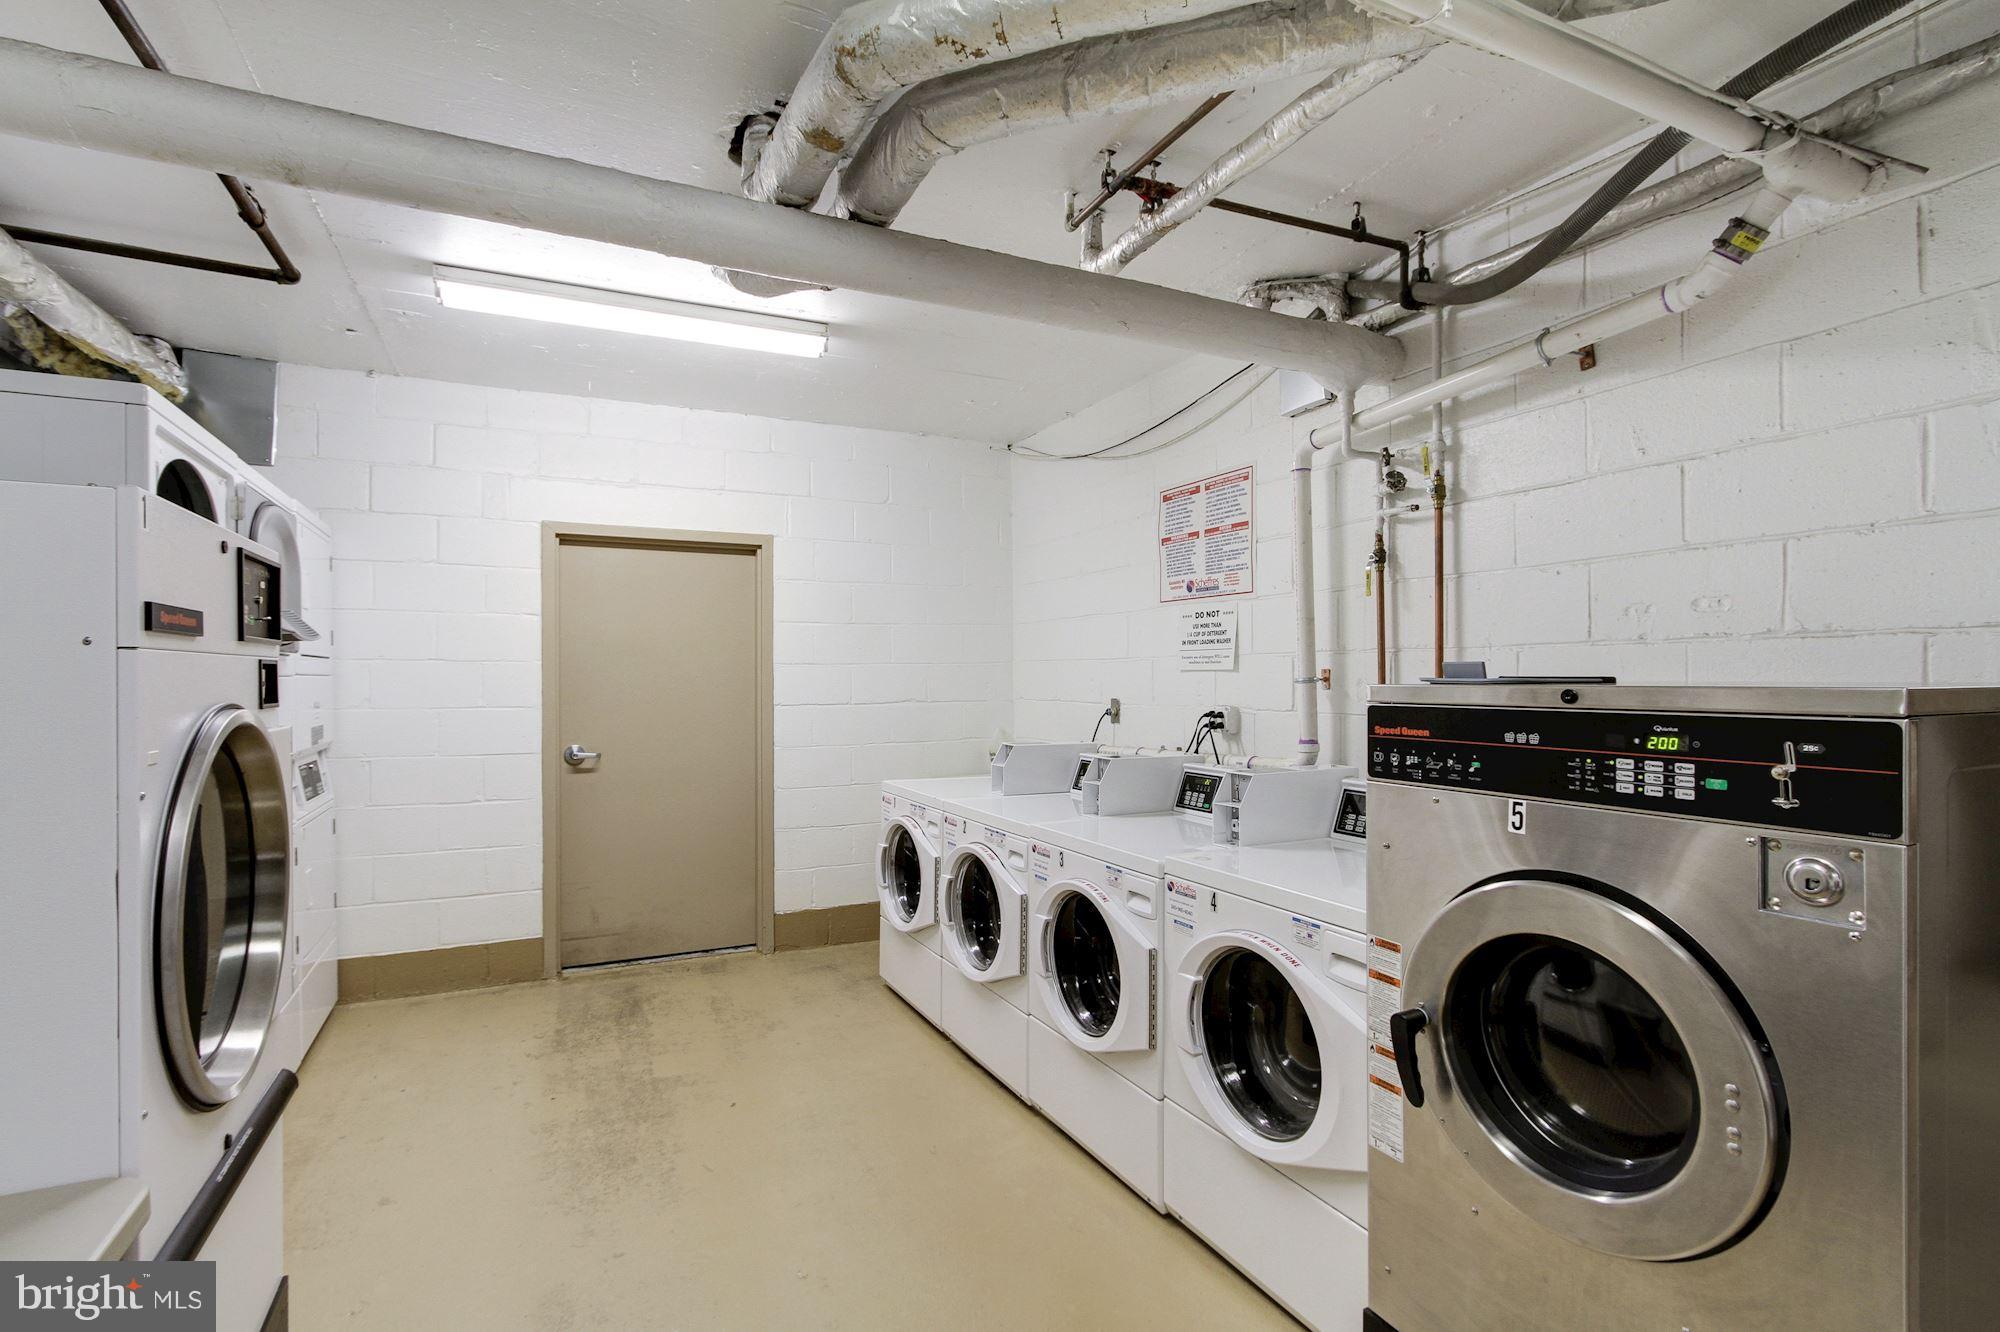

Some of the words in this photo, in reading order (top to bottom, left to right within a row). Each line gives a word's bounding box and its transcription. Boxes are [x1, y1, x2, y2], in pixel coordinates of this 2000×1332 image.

[1206, 610, 1220, 618] NOT
[1207, 629, 1227, 637] DETERGENT
[1374, 725, 1400, 736] Speed
[1402, 727, 1430, 737] Queen
[1647, 736, 1678, 750] 200
[1510, 801, 1524, 831] 5
[962, 820, 967, 834] 2
[1059, 852, 1064, 867] 3
[1210, 892, 1217, 912] 4
[1260, 939, 1281, 952] WHEN
[1281, 952, 1302, 968] DONE
